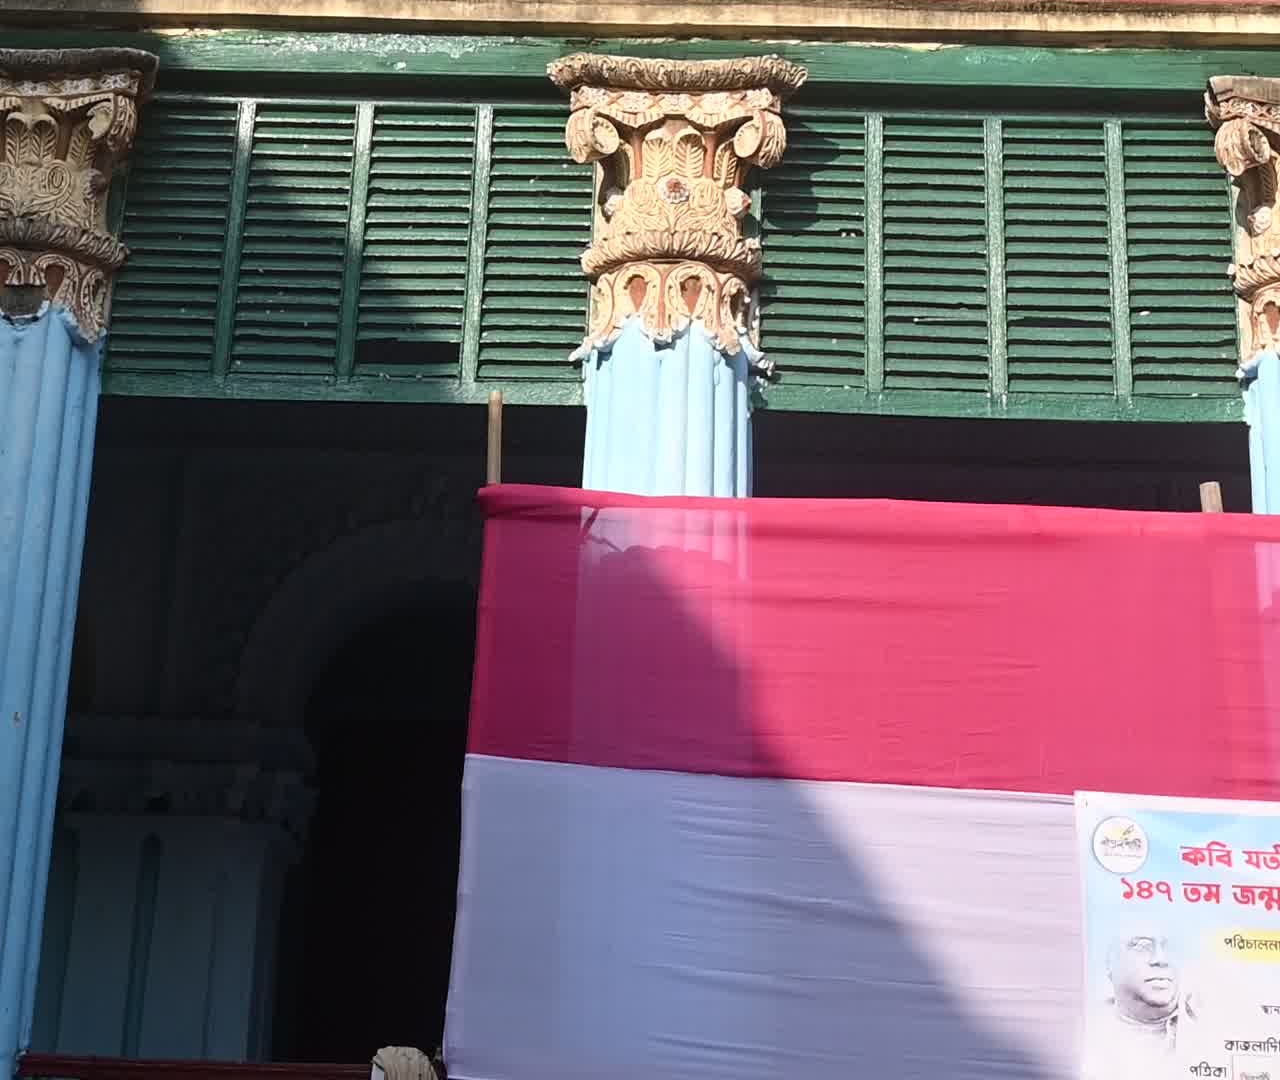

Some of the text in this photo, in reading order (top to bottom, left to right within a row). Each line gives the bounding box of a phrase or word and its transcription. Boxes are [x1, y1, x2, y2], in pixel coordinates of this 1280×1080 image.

[1180, 841, 1232, 867] কবি
[1120, 877, 1173, 902] ১৪৭
[1182, 883, 1221, 904] তম
[1190, 1061, 1227, 1078] পত্রিকা
